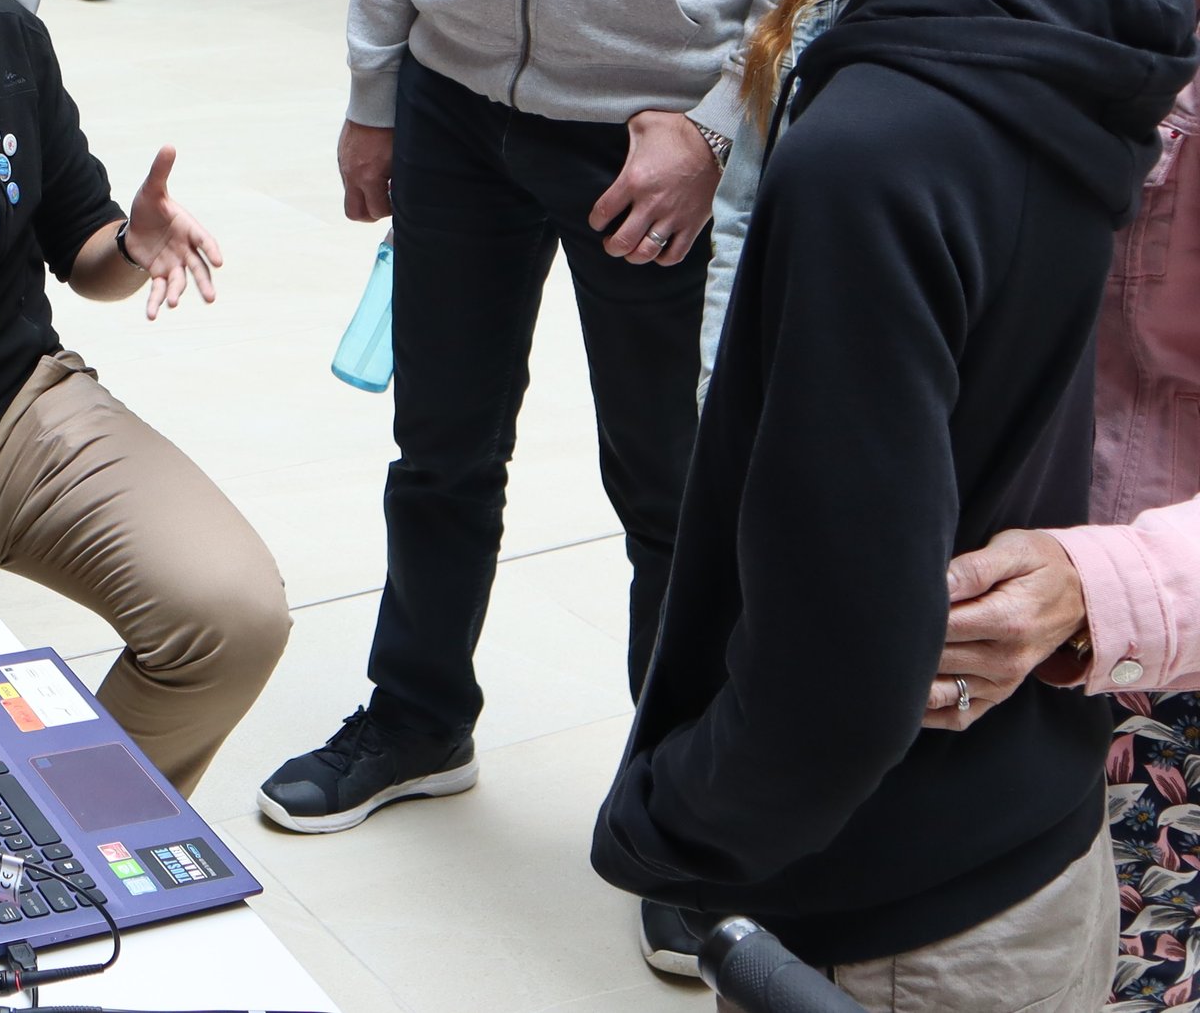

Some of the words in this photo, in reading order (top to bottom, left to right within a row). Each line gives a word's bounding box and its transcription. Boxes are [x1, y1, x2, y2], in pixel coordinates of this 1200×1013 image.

[154, 848, 173, 859] ME
[1, 871, 13, 888] CE
[162, 860, 192, 883] TRUST
